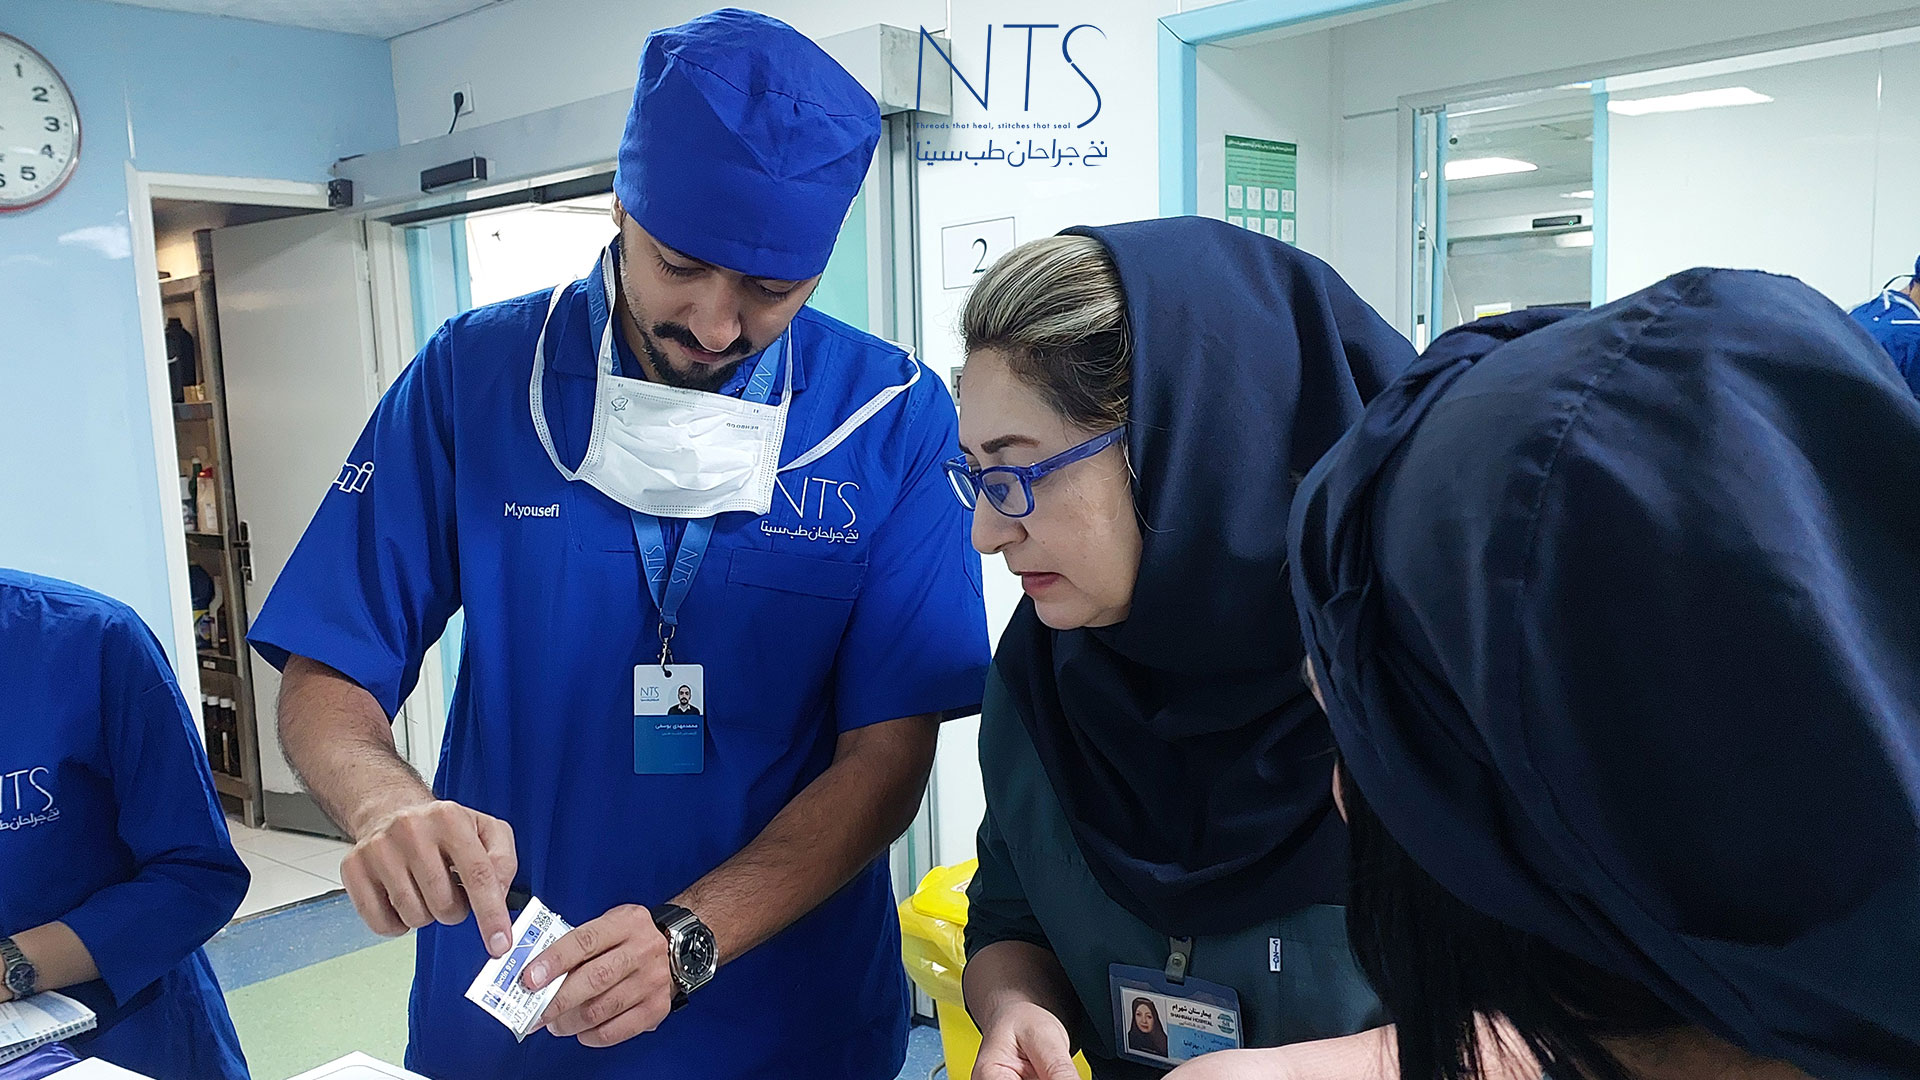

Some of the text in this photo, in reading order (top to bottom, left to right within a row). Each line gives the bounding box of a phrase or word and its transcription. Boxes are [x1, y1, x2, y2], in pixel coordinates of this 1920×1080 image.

[14, 62, 23, 78] 1
[32, 86, 49, 102] 2
[44, 116, 60, 132] 3
[41, 144, 54, 158] 4
[21, 166, 36, 181] 5
[971, 238, 988, 275] 2
[747, 364, 772, 399] NTS
[504, 502, 560, 519] M.yousefi
[768, 476, 860, 529] NTS
[761, 520, 859, 543] نخ جراحان طب سینا
[644, 545, 667, 582] NTS
[672, 548, 698, 585] NTS
[641, 687, 659, 698] NTS
[0, 767, 53, 814] TS
[10, 813, 47, 830] جراحان
